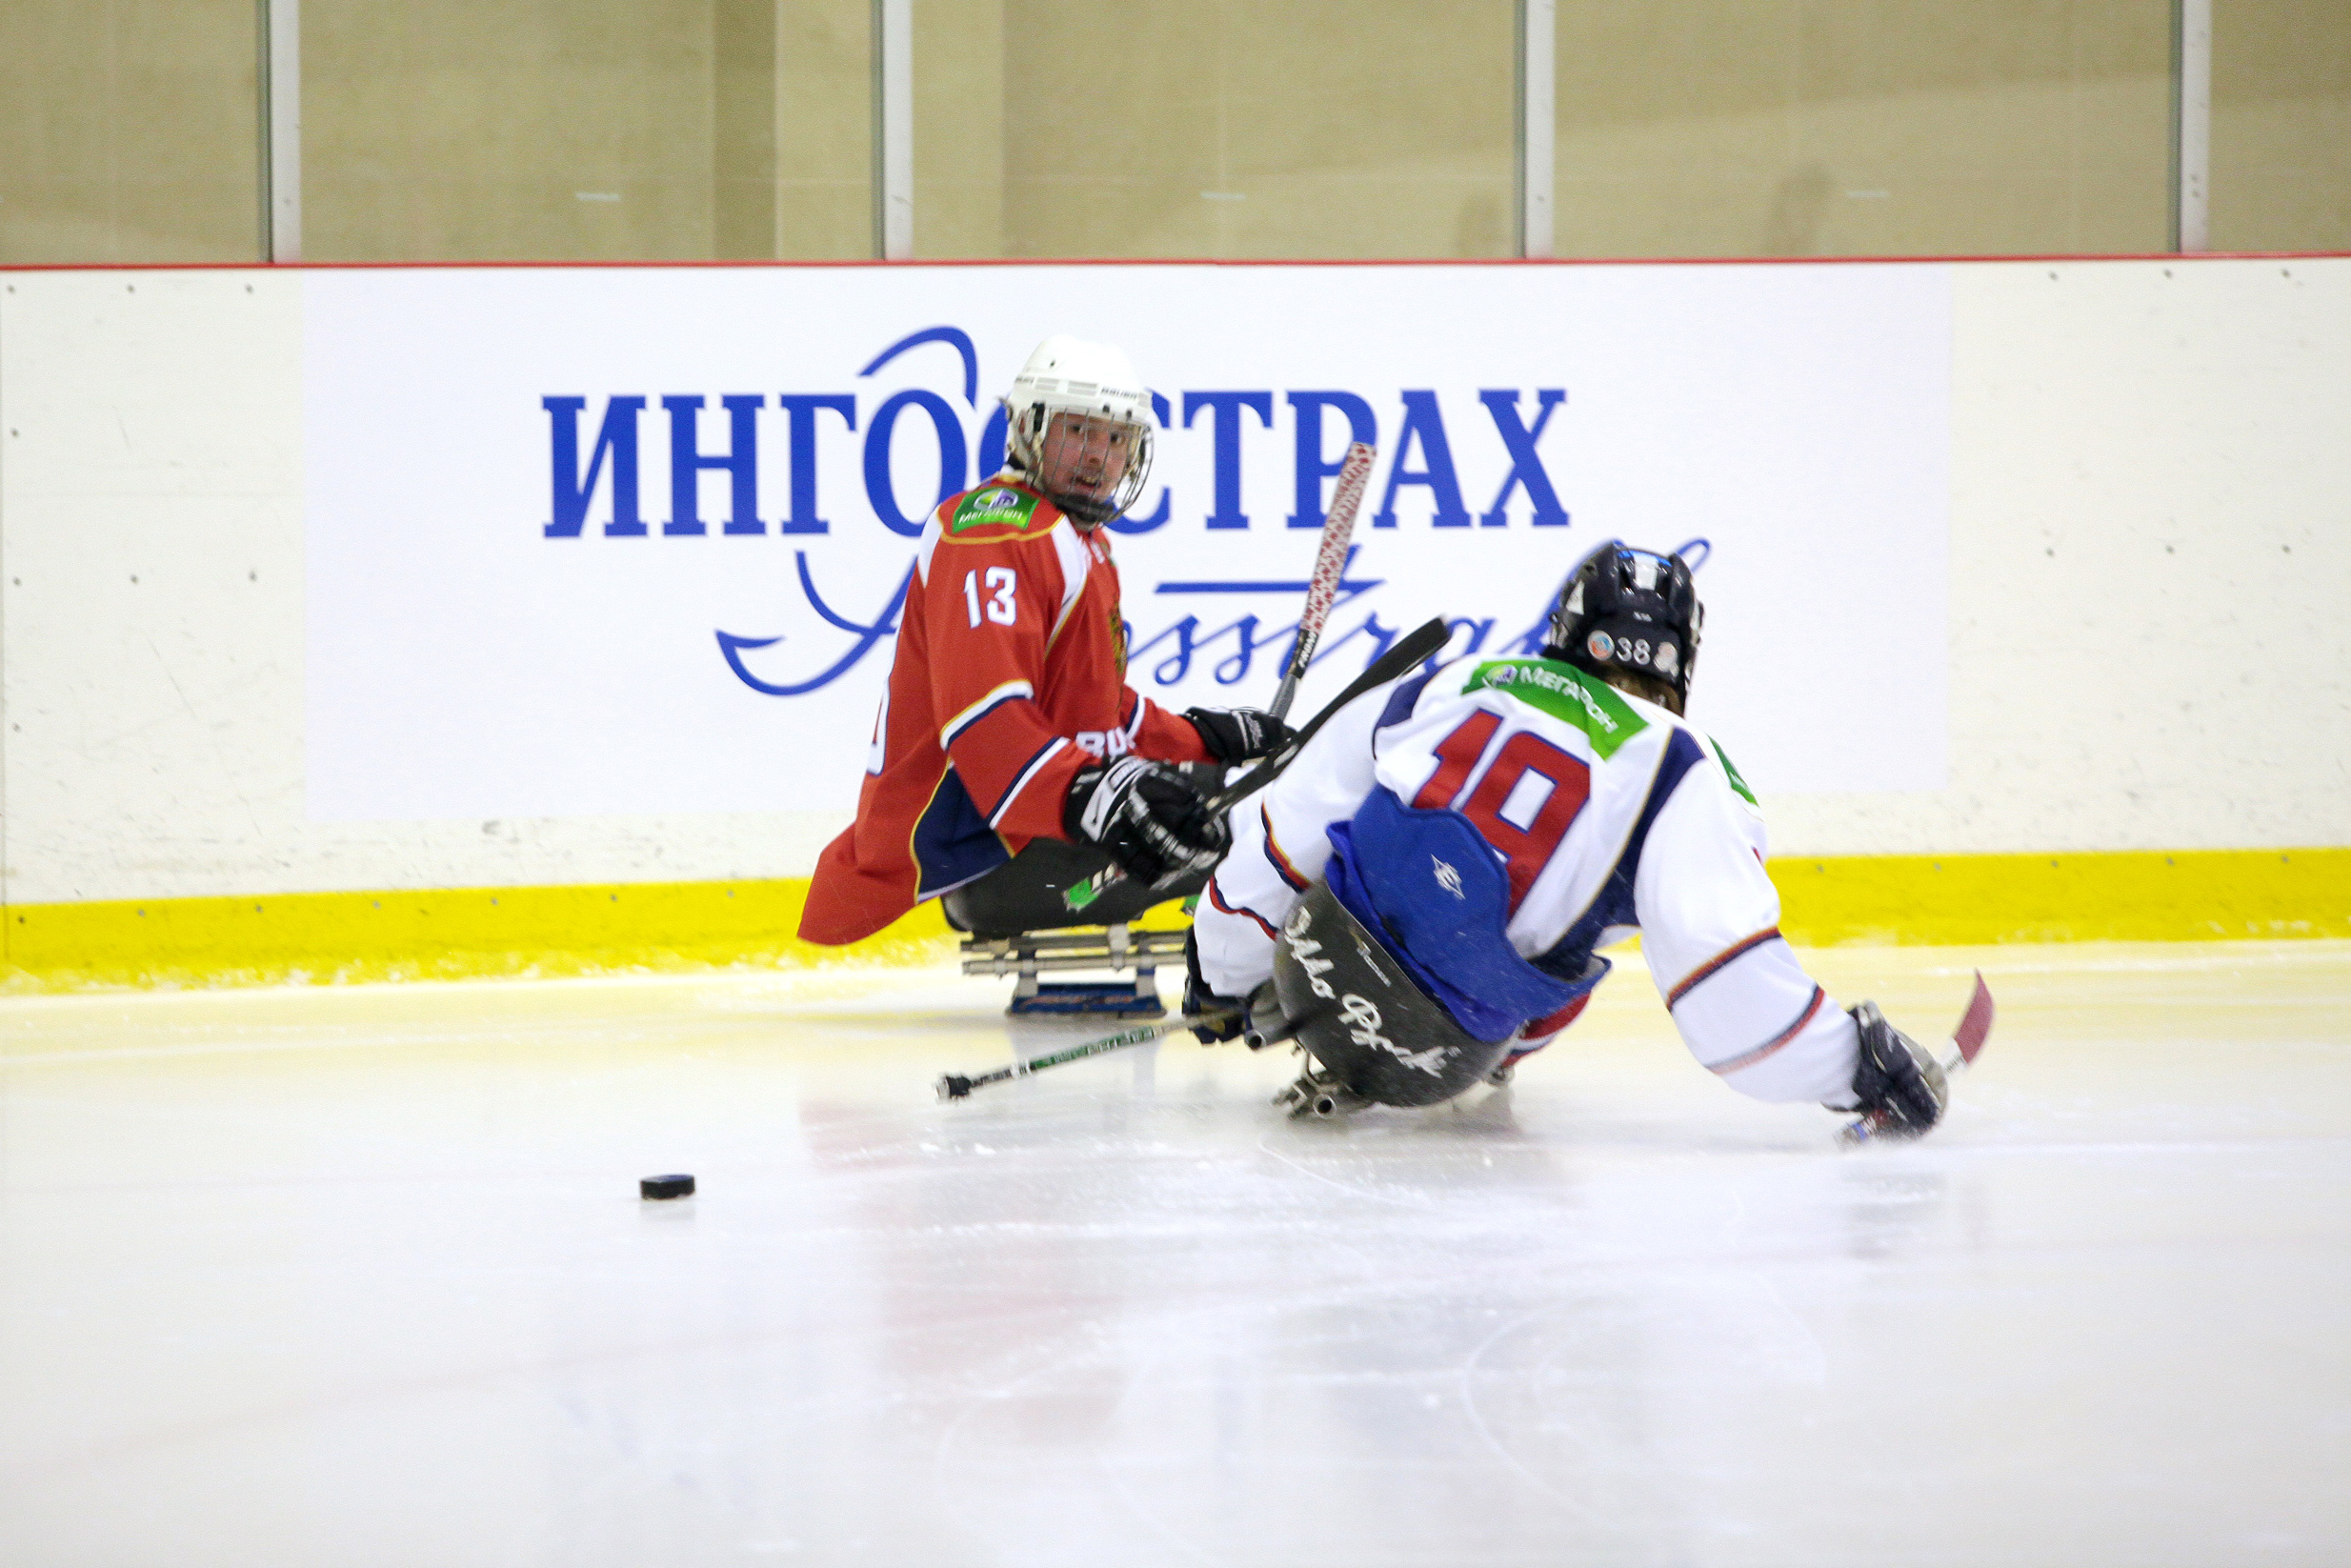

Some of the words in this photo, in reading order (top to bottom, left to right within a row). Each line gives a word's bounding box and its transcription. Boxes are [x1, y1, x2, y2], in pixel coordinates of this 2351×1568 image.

[962, 565, 1017, 630] 13
[1616, 636, 1651, 666] 38
[1075, 726, 1136, 759] RU
